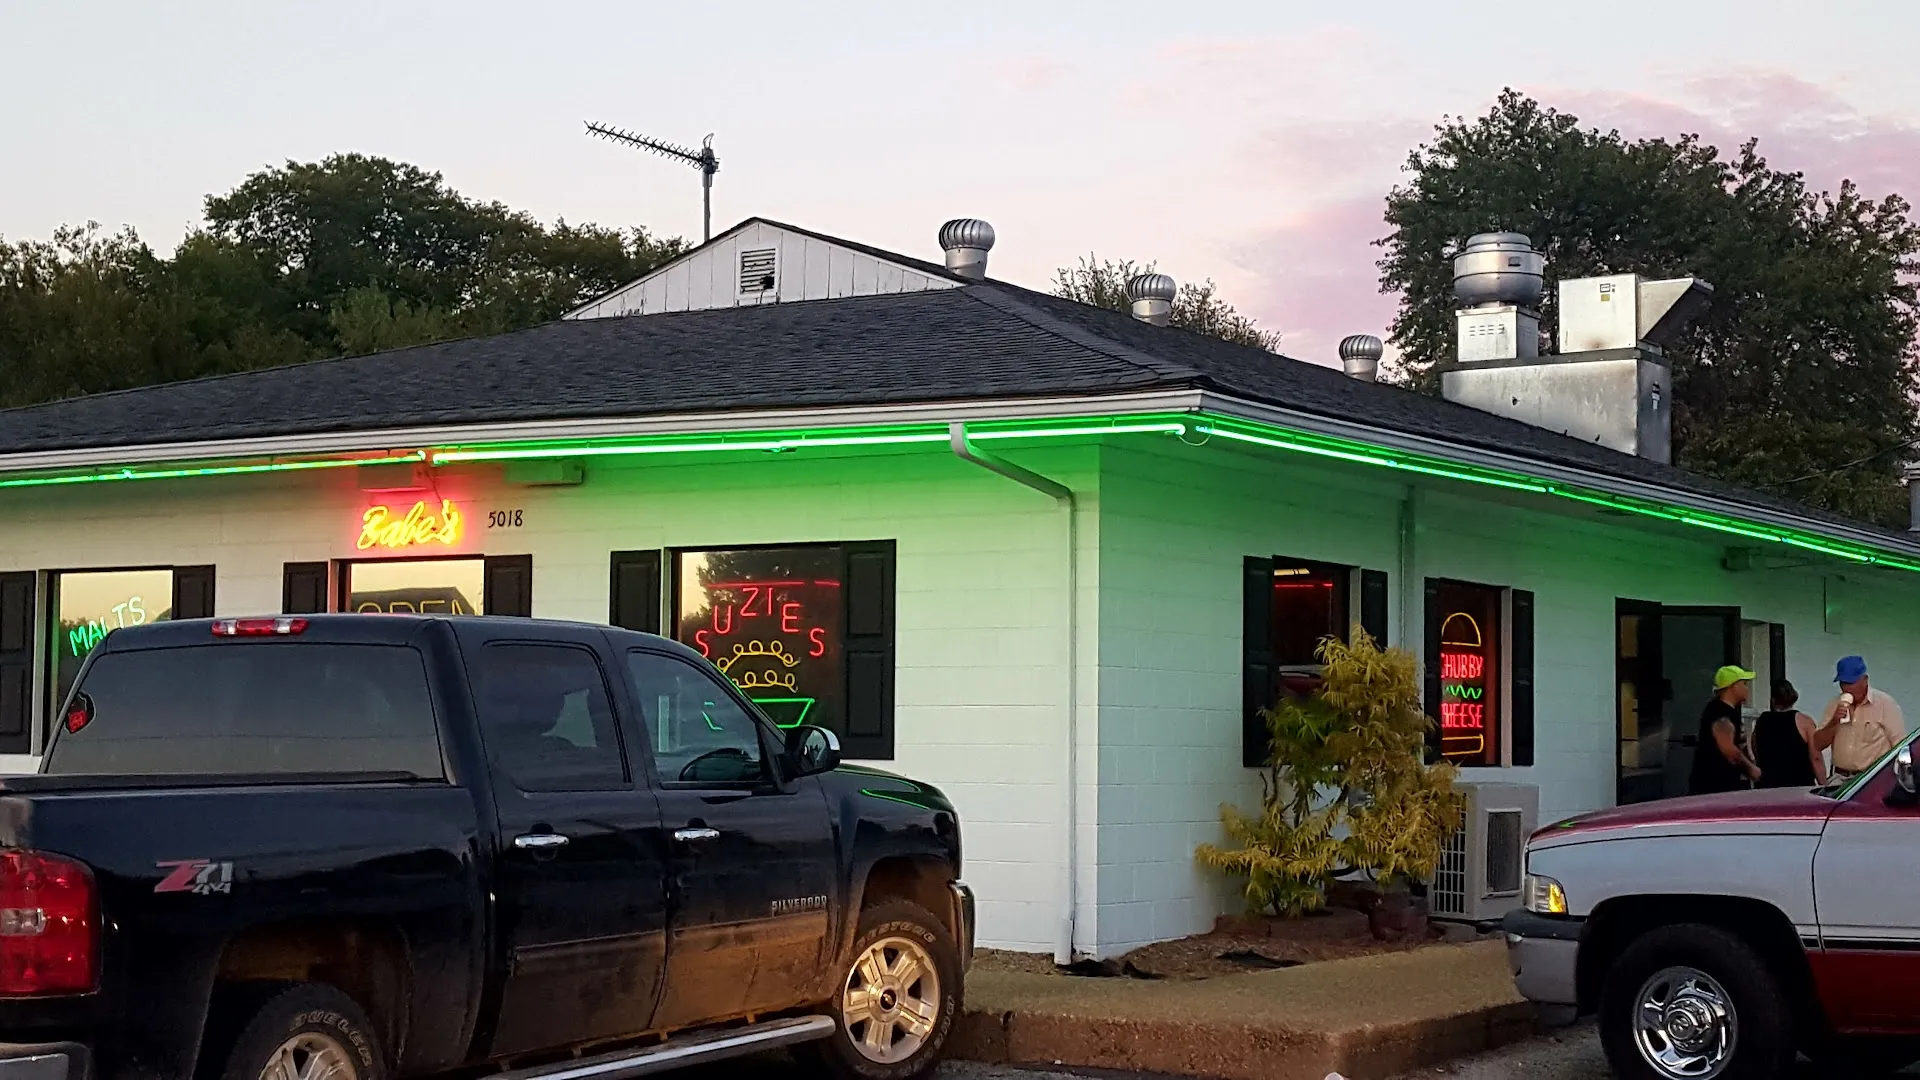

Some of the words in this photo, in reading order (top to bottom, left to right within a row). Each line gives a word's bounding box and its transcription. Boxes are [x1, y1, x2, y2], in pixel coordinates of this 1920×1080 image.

[356, 499, 460, 550] Babe's
[487, 509, 524, 529] 5018
[694, 586, 826, 658] SUZIES
[153, 858, 234, 894] Z71
